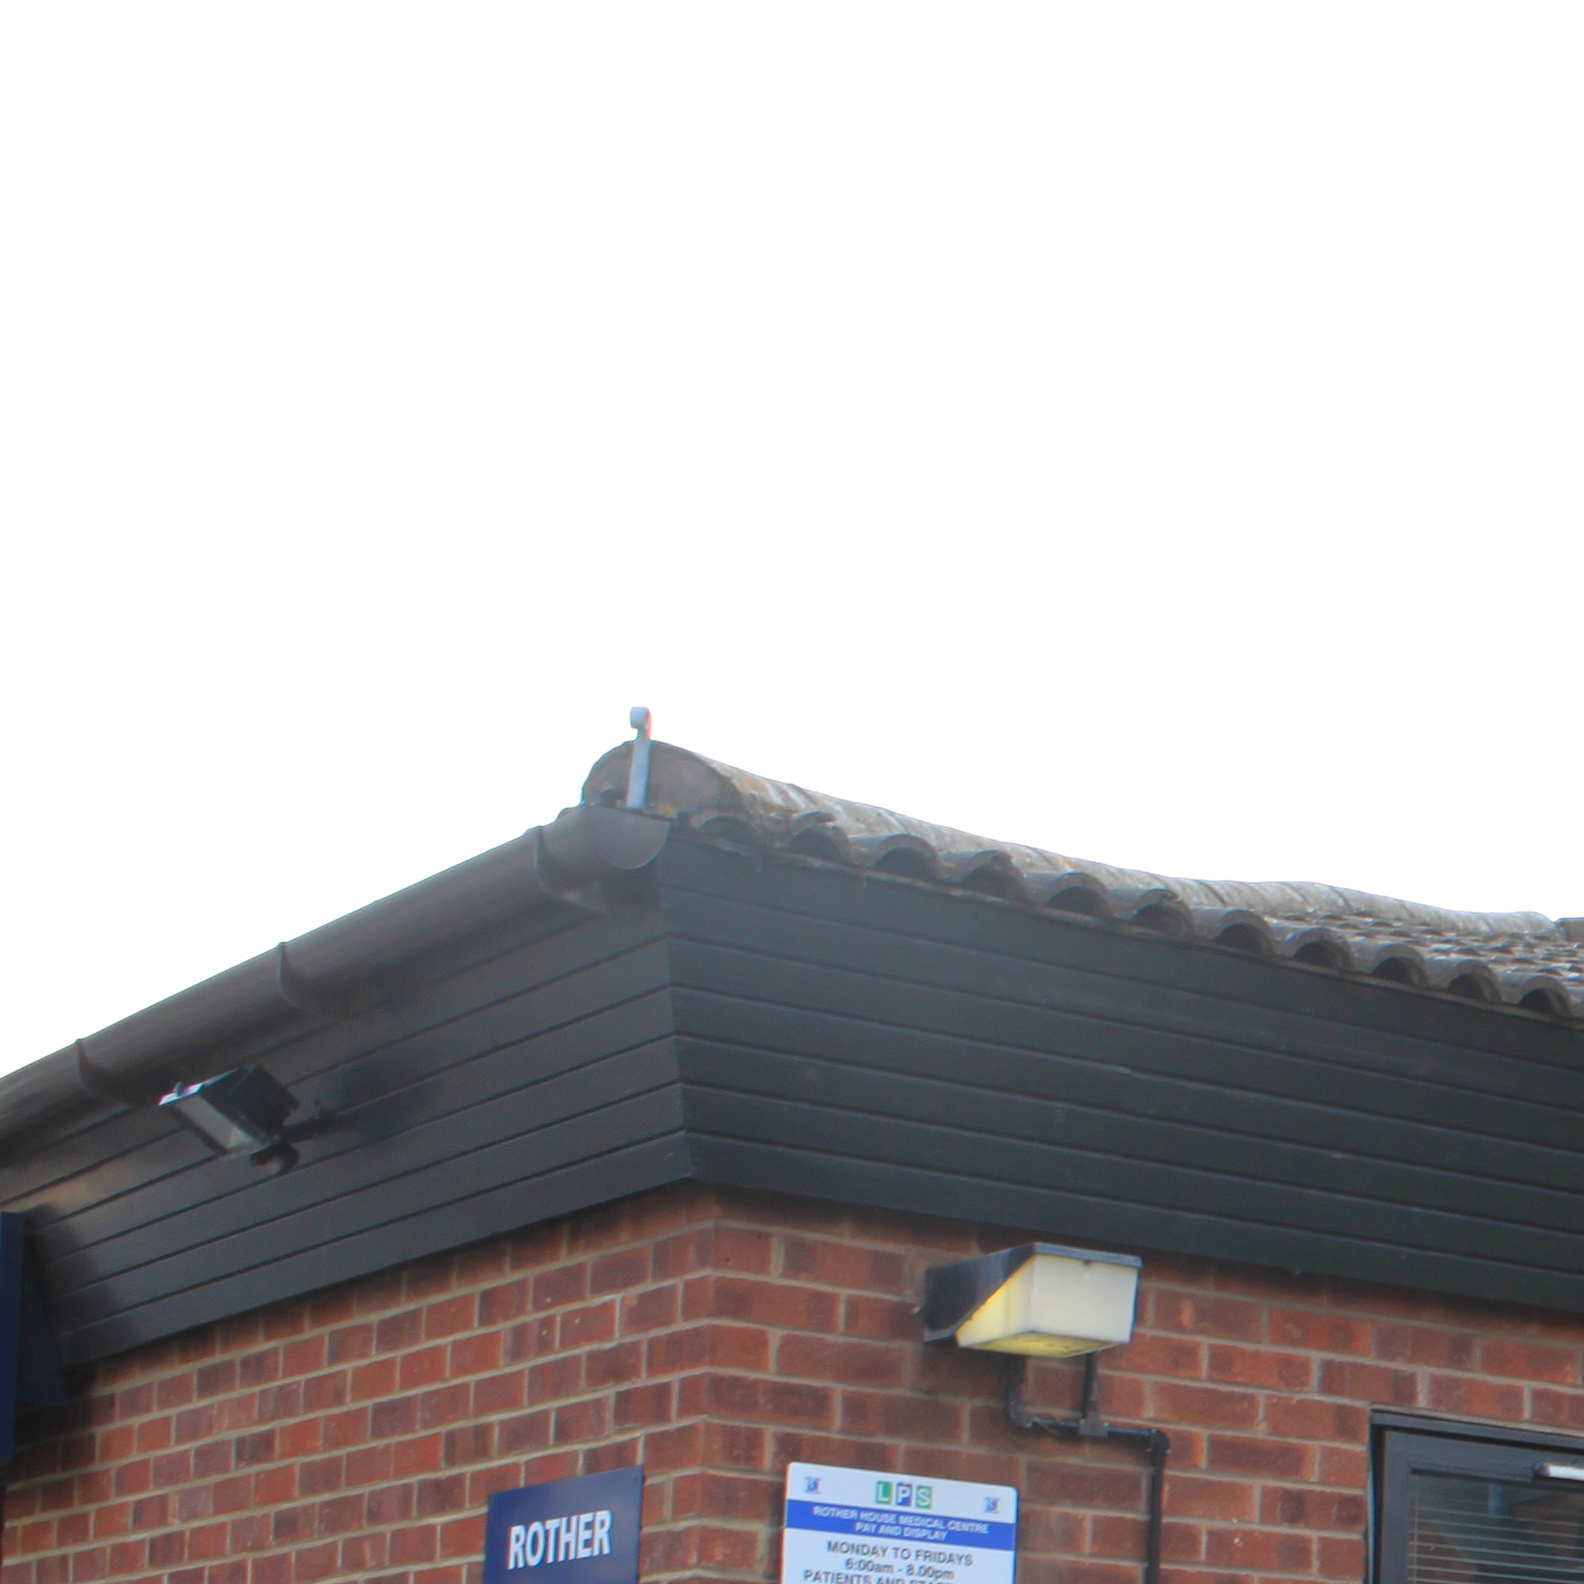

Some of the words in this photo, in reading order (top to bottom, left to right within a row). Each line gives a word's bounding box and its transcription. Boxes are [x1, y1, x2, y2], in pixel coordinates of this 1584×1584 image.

[813, 1505, 858, 1520] ROTHER
[860, 1511, 896, 1524] HOUSE
[899, 1514, 944, 1530] MEDICAL
[947, 1520, 989, 1534] CENTRE
[855, 1521, 877, 1533] PAY
[879, 1524, 901, 1536] AND
[904, 1526, 948, 1541] DISPLAY
[508, 1509, 612, 1570] ROTHER
[827, 1540, 889, 1558] MONDAY
[892, 1546, 911, 1560] TO
[915, 1549, 973, 1566] FRIDAYS
